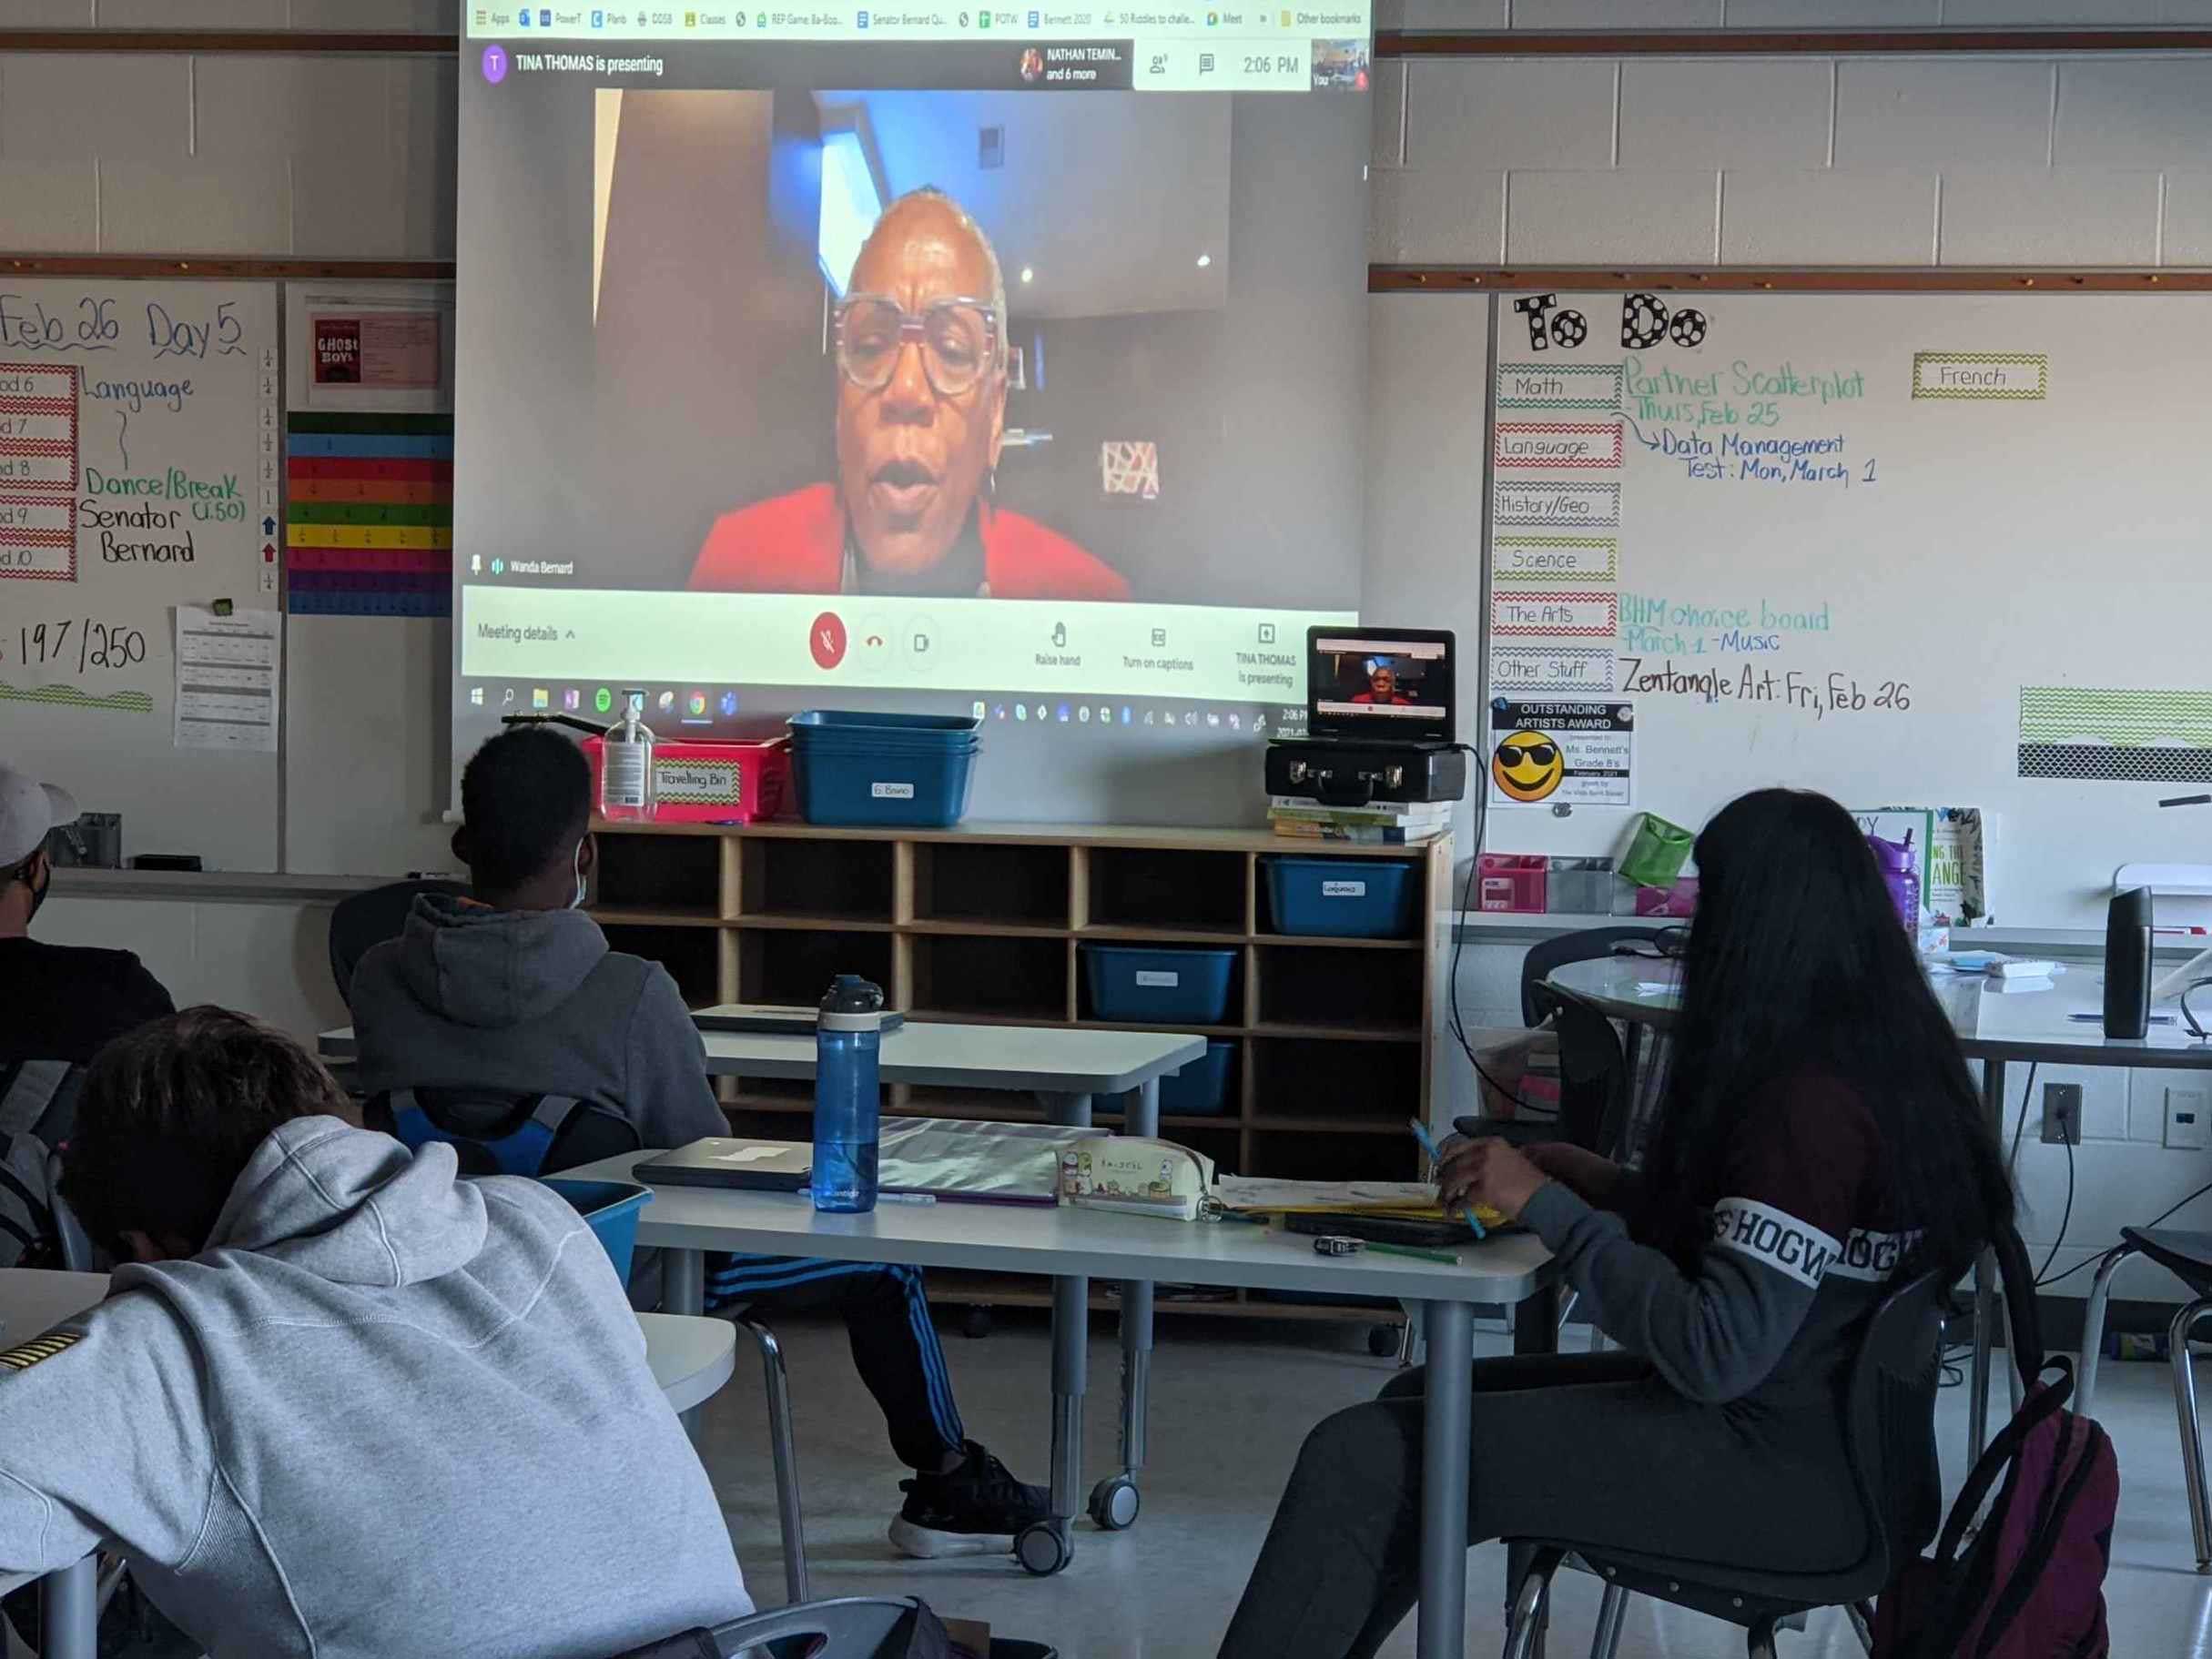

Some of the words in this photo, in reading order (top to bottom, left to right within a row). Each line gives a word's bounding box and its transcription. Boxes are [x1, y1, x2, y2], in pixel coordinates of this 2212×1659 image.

[1223, 14, 1243, 25] Meet
[1297, 13, 1318, 25] Other
[1320, 13, 1362, 25] bookmarks
[490, 55, 499, 71] T
[1047, 48, 1085, 61] NATHAN
[516, 55, 543, 71] TINA
[545, 55, 594, 72] THOMAS
[596, 56, 605, 72] is
[607, 56, 664, 76] presenting
[1243, 56, 1271, 73] 2:06
[1277, 56, 1299, 73] PM
[1047, 69, 1064, 80] and
[1065, 69, 1071, 80] 6
[1072, 70, 1096, 80] more
[1314, 75, 1329, 86] You
[0, 294, 63, 344] Feb
[77, 298, 118, 340] 26
[147, 303, 209, 359] Day
[218, 302, 242, 344] 5
[1514, 293, 1588, 351] To
[1620, 292, 1707, 349] Do
[24, 378, 35, 392] 6
[1624, 359, 1720, 399] Partner
[1732, 360, 1865, 404] Scatterplot
[1940, 366, 2006, 386] French
[81, 366, 194, 412] Language
[1516, 377, 1563, 396] Math
[1702, 399, 1739, 425] Feb
[1747, 402, 1780, 427] 25
[18, 418, 27, 433] 7
[1504, 440, 1589, 458] Language
[1661, 429, 1712, 455] Data
[1721, 432, 1844, 463] Management
[20, 460, 30, 476] 8
[1684, 457, 1734, 480] Test:
[1791, 457, 1850, 489] March
[1862, 458, 1877, 482] 1
[86, 467, 242, 500] Dance/Break
[1501, 493, 1589, 515] History/Geo
[18, 507, 28, 521] 9
[79, 500, 182, 530] Senator
[101, 531, 194, 562] Bernard
[16, 550, 33, 566] 10
[511, 561, 539, 574] Wanda
[541, 561, 573, 574] Bernard
[1512, 550, 1578, 569] Science
[1507, 603, 1537, 623] The
[1541, 603, 1573, 624] Arts
[1671, 602, 1750, 628] choice
[1760, 599, 1831, 632] board
[478, 623, 521, 643] Meeting
[523, 626, 558, 642] details
[1035, 652, 1057, 666] Raise
[1059, 653, 1081, 666] hand
[1123, 655, 1142, 669] Turn
[1143, 659, 1153, 669] on
[1157, 657, 1193, 673] captions
[1236, 652, 1257, 666] TINA
[1258, 652, 1296, 667] THOMAS
[1239, 670, 1245, 683] is
[1247, 672, 1293, 689] presenting
[1497, 662, 1540, 679] Other
[1547, 661, 1588, 680] Stuff
[1618, 657, 1732, 701] Zentangle
[1828, 673, 1866, 711] Feb
[1872, 681, 1911, 711] 26
[1520, 703, 1607, 715] OUTSTANDING
[1515, 717, 1566, 729] ARTISTS
[1567, 718, 1611, 729] AWARD
[1586, 744, 1629, 755] Bennett's
[1574, 759, 1603, 768] Grade
[657, 770, 707, 789] Travelling
[709, 772, 727, 786] Bin
[1932, 862, 1966, 885] ANGE
[1732, 1209, 1838, 1282] HOGW
